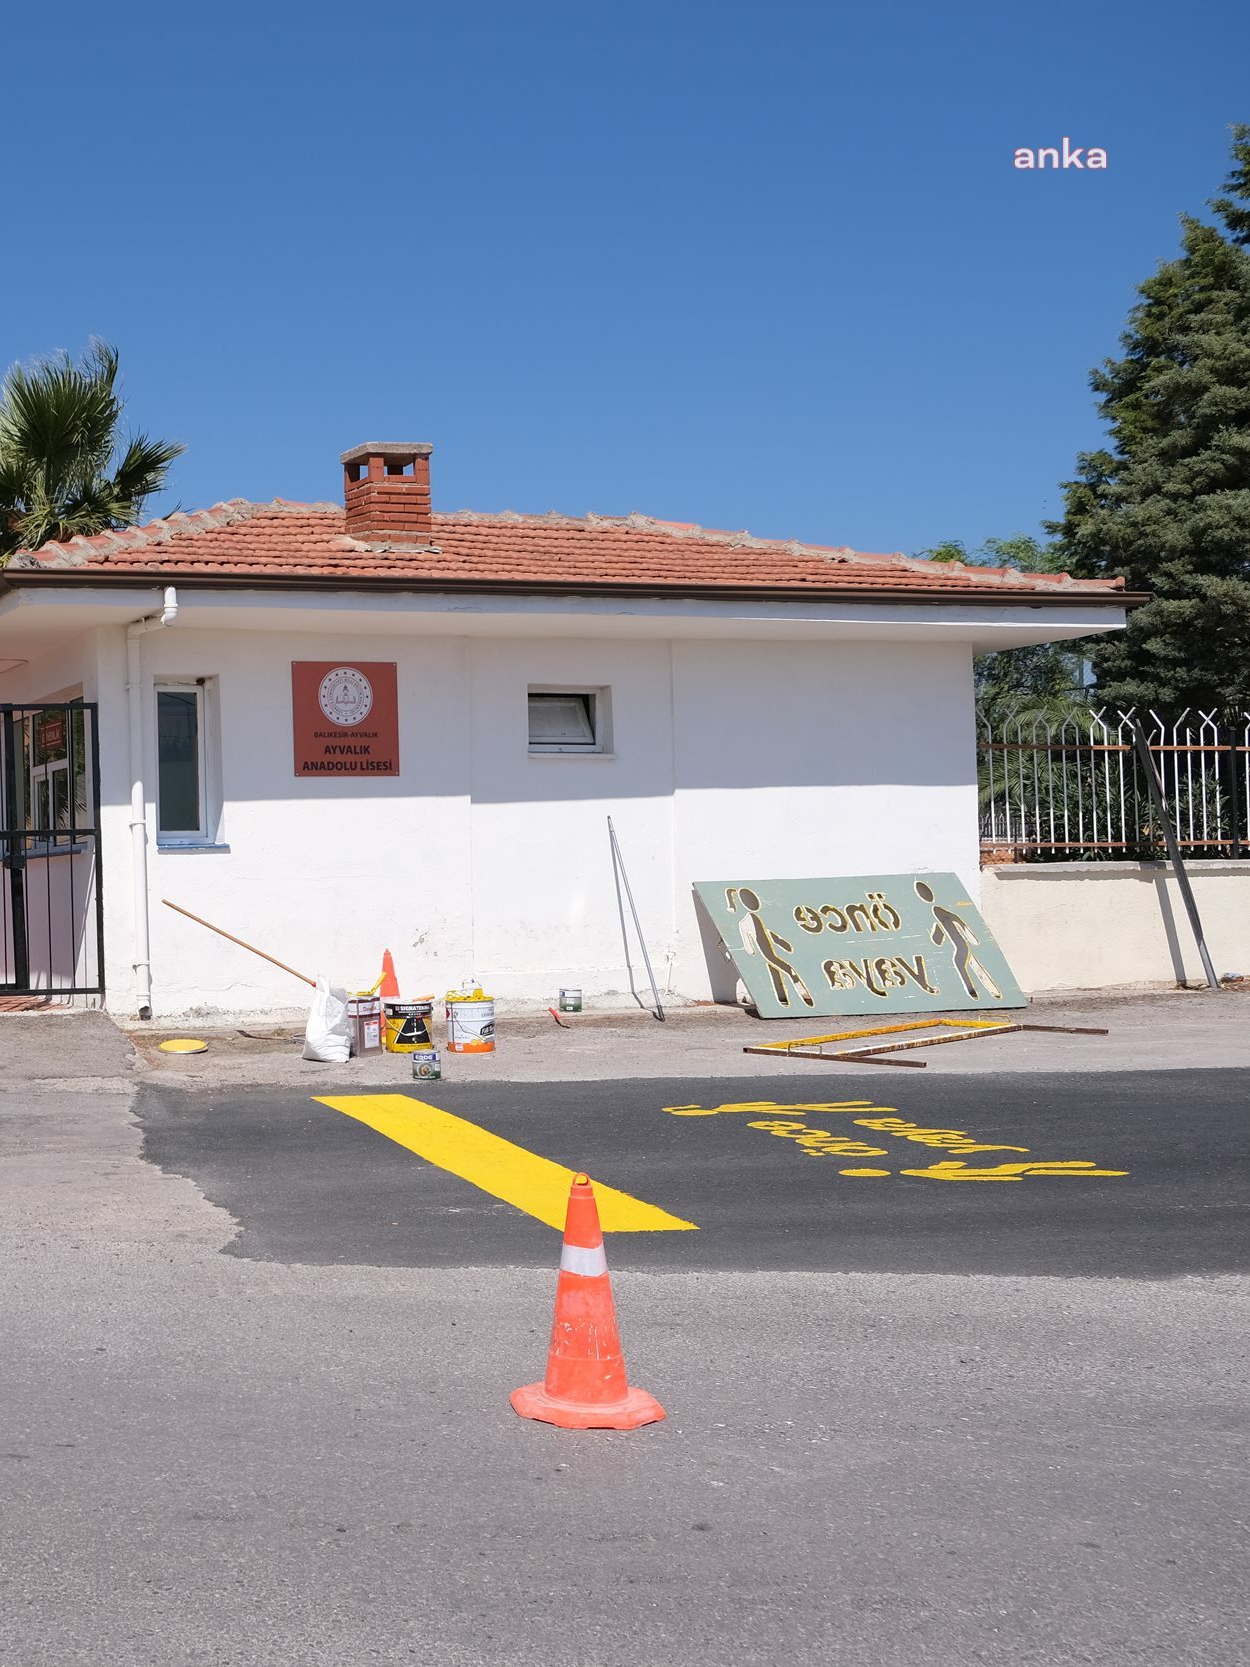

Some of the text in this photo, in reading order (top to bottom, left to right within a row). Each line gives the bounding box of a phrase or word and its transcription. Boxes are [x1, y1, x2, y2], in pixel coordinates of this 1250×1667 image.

[314, 730, 379, 738] BALIKESİR-AYVALIK
[324, 745, 371, 755] AYVALIK
[302, 759, 392, 771] ANADOLU LİSESİ
